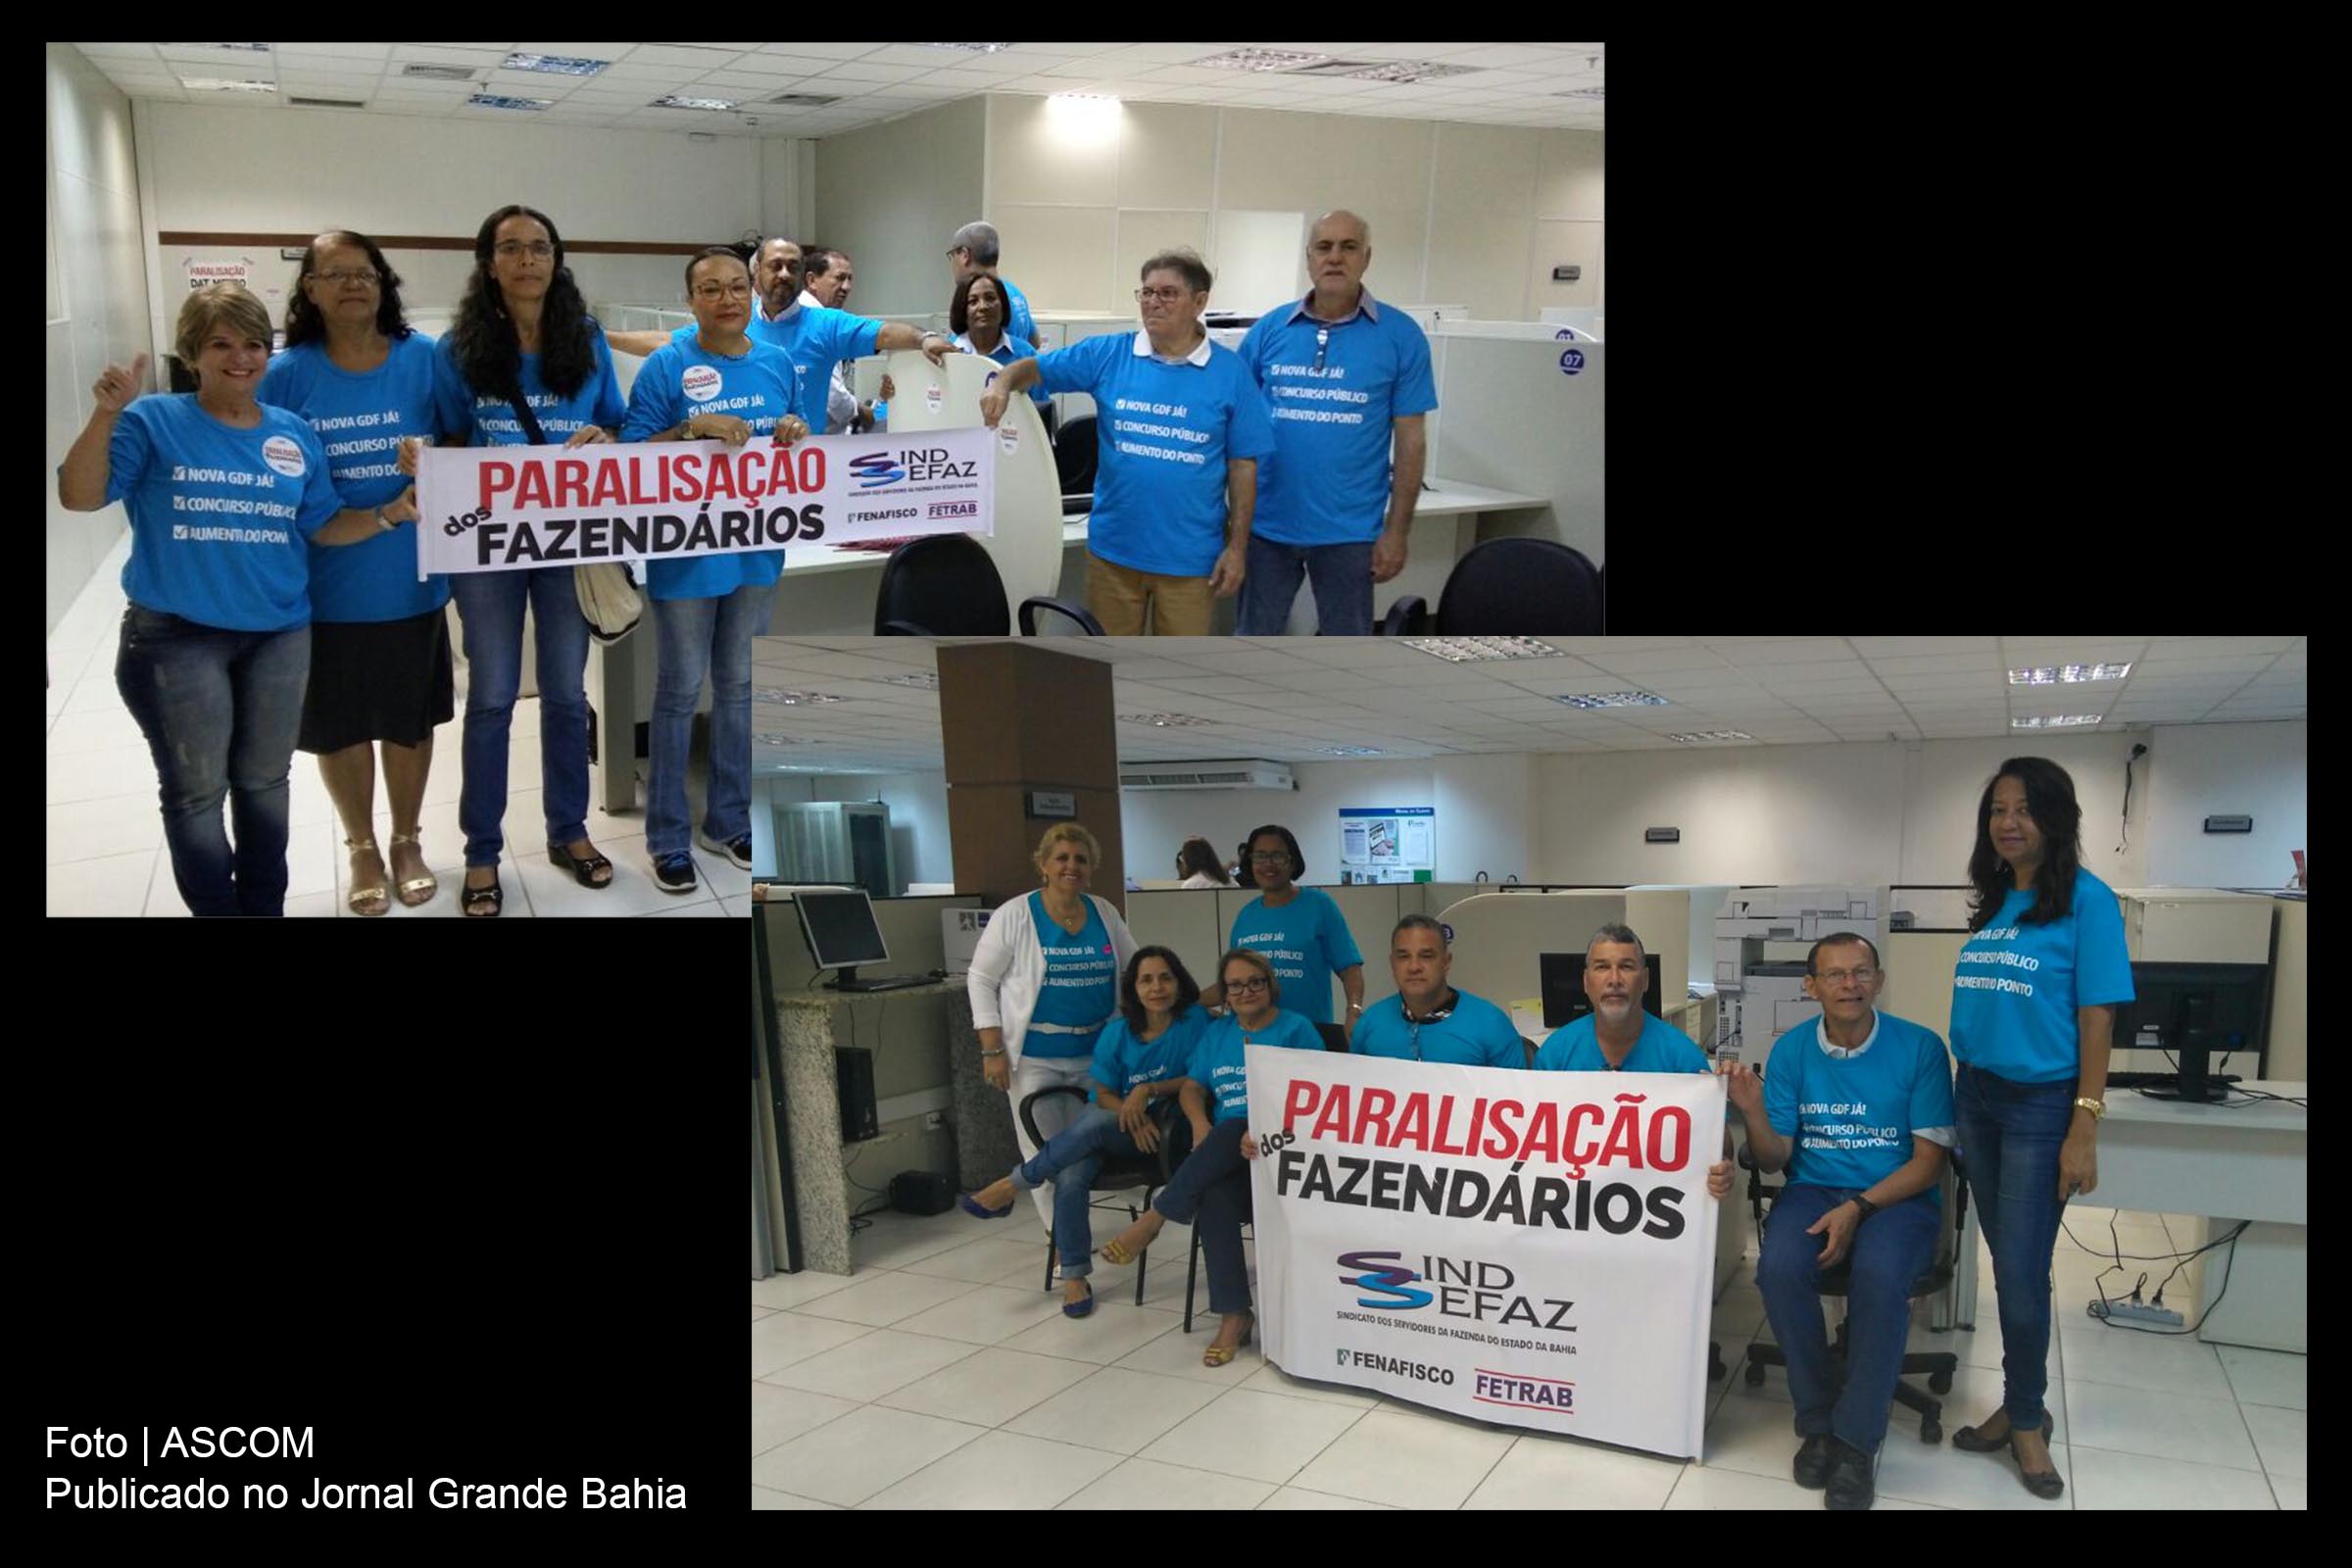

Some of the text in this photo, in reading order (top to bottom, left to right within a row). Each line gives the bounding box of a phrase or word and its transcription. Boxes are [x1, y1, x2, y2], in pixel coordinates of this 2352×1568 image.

[1564, 354, 1581, 367] 07
[1281, 365, 1305, 376] NOVA
[701, 394, 764, 415] NOVA GDF JÁ!
[1327, 388, 1368, 404] PÚBLICO
[1126, 400, 1152, 413] NOVA
[1152, 403, 1172, 416] GDF
[1317, 412, 1331, 422] DO
[322, 410, 400, 431] NOVA GDF JÁ!
[1123, 420, 1170, 437] CONCURSO
[325, 438, 387, 457] CONCURSO
[1162, 448, 1176, 461] DO
[188, 468, 274, 488] NOVA GDF JÁ!
[478, 441, 827, 509] PARALISAÇÃO
[187, 497, 254, 514] CONCURSO
[858, 503, 977, 522] FENAFISCO FETRAB
[443, 504, 492, 537] dos
[245, 529, 260, 543] DO
[477, 501, 825, 566] FAZENDÁRIOS
[1996, 978, 2033, 997] PONTO
[1831, 1103, 1849, 1115] GDF
[1850, 1102, 1867, 1116] JÁ!
[1283, 1079, 1691, 1180] PARALISAÇÃO
[1258, 1127, 1297, 1158] dos
[1277, 1149, 1686, 1241] FAZENDÁRIOS
[1337, 1311, 1577, 1355] SINDICATO DOS SERVIDORES DA FAZENDA DO ESTADO DA BAHIA
[1353, 1350, 1573, 1408] FENAFISCO FETRAB
